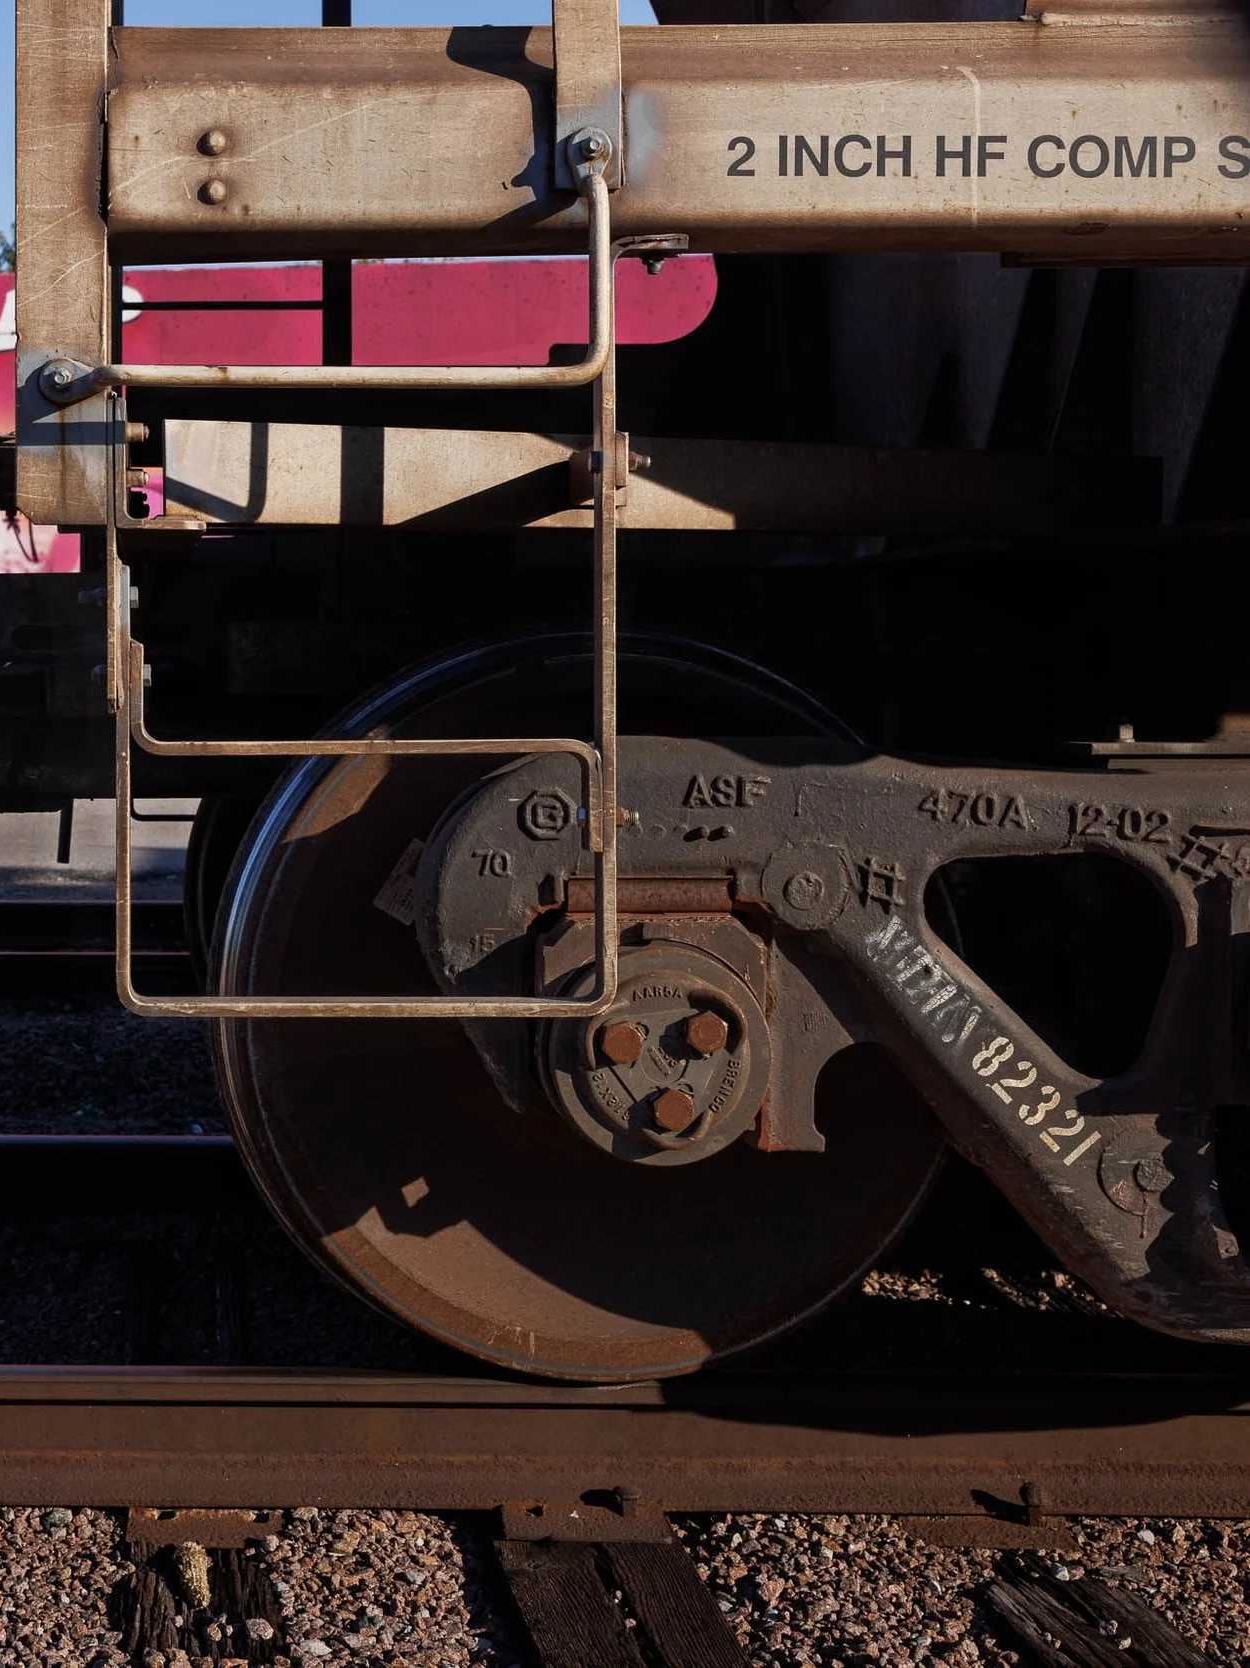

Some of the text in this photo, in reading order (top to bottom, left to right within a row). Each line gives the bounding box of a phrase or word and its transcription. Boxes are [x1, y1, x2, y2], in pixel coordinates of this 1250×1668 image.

[727, 135, 756, 178] 2
[778, 134, 912, 178] INCH
[936, 135, 1008, 178] HF
[1027, 134, 1196, 179] COMP
[682, 773, 771, 808] ASF
[918, 787, 1171, 844] 470A 12-02
[471, 850, 513, 878] 70
[972, 1034, 1102, 1167] 82321
